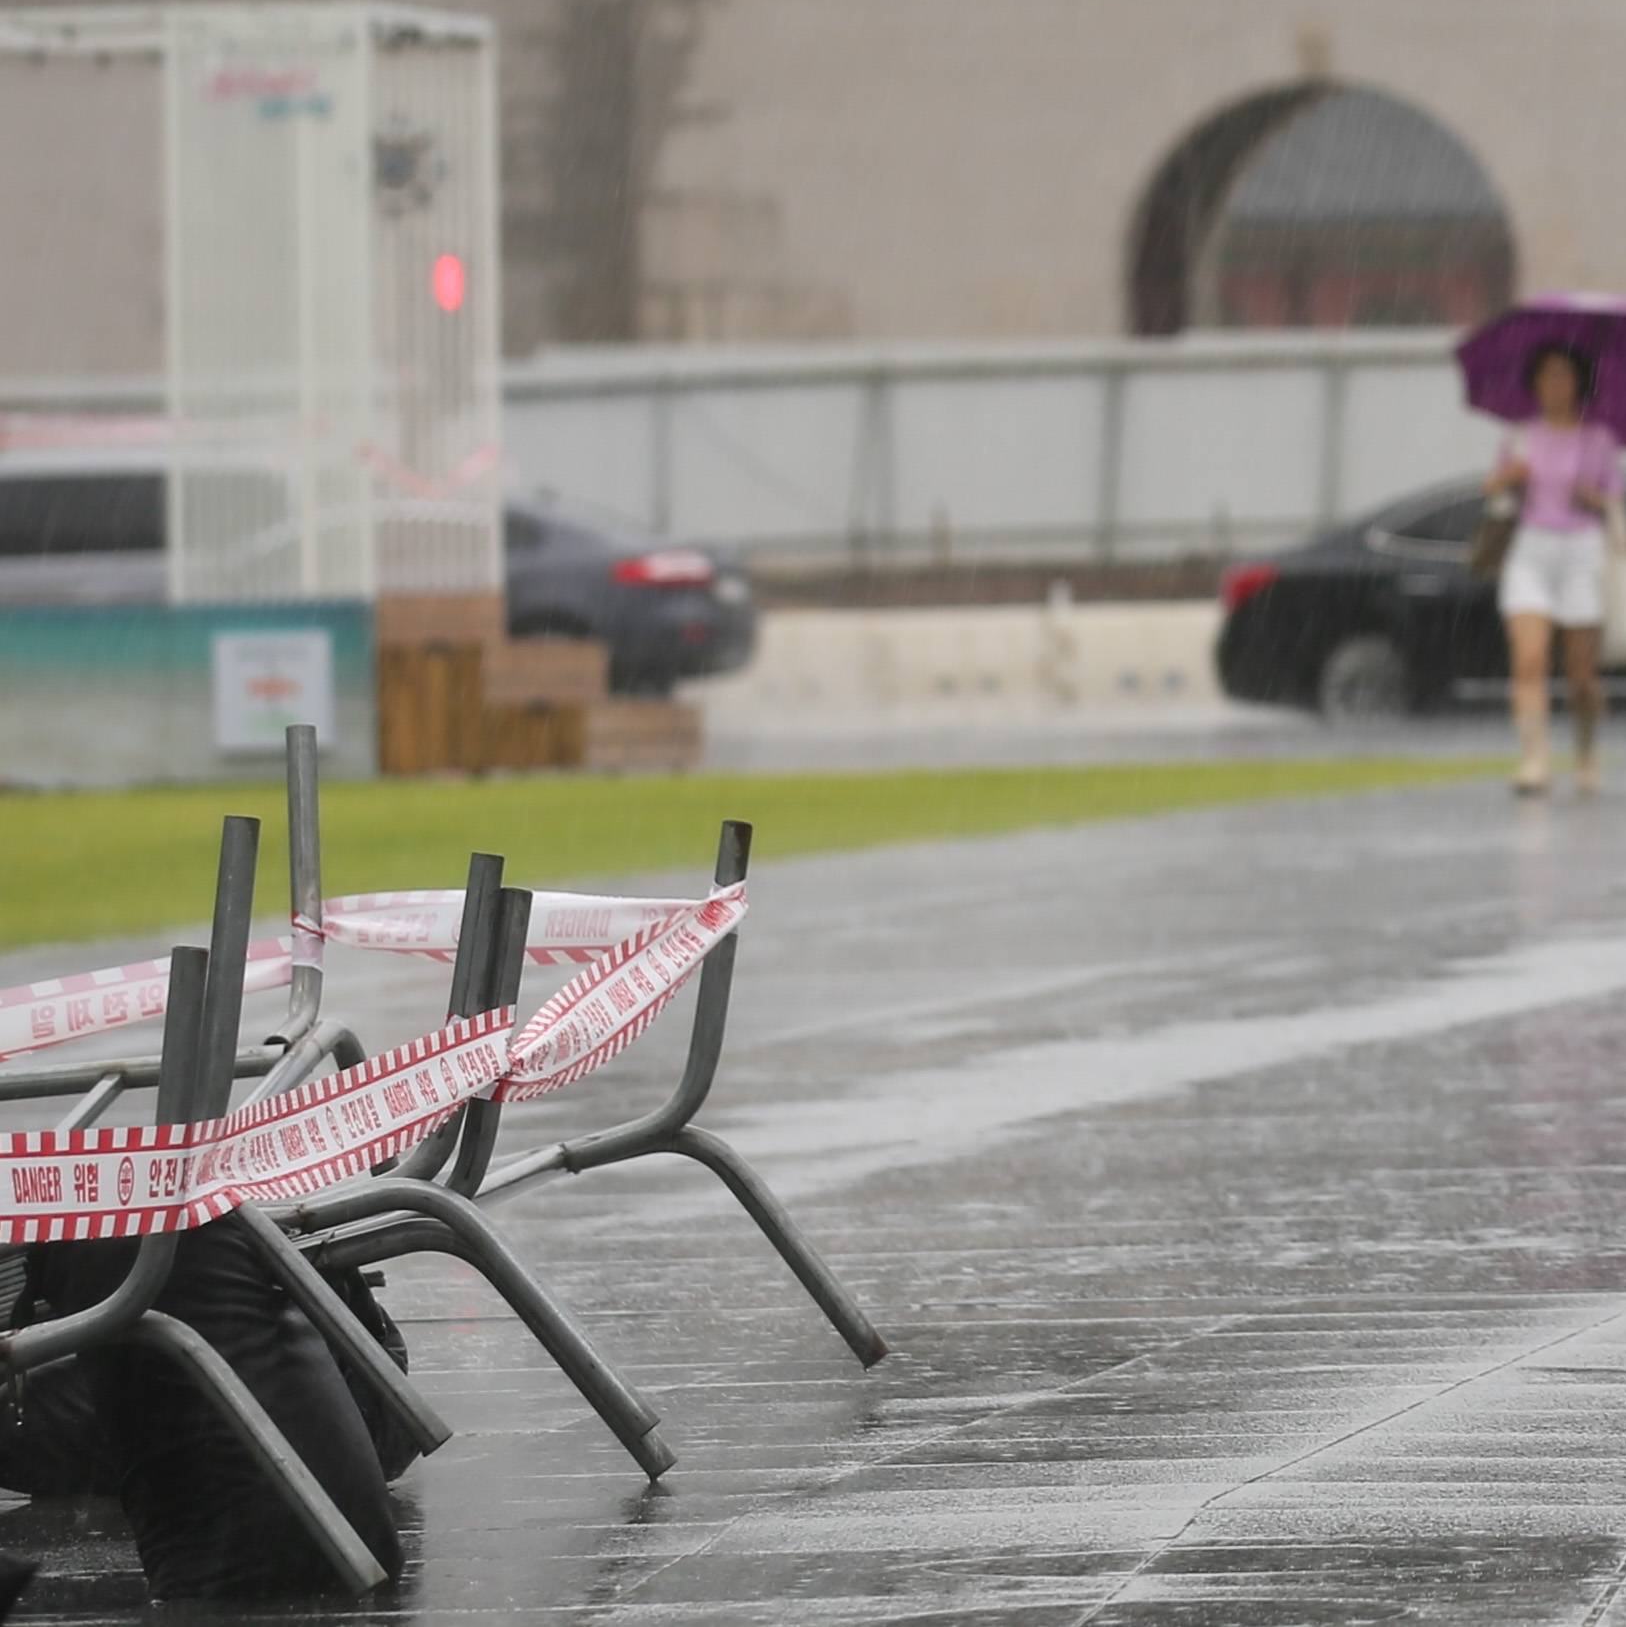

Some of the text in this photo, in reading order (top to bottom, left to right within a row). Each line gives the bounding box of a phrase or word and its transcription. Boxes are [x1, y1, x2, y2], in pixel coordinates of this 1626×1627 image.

[11, 1165, 62, 1204] DANGER
[73, 1162, 99, 1203] 위험
[457, 1043, 501, 1088] 안전제일
